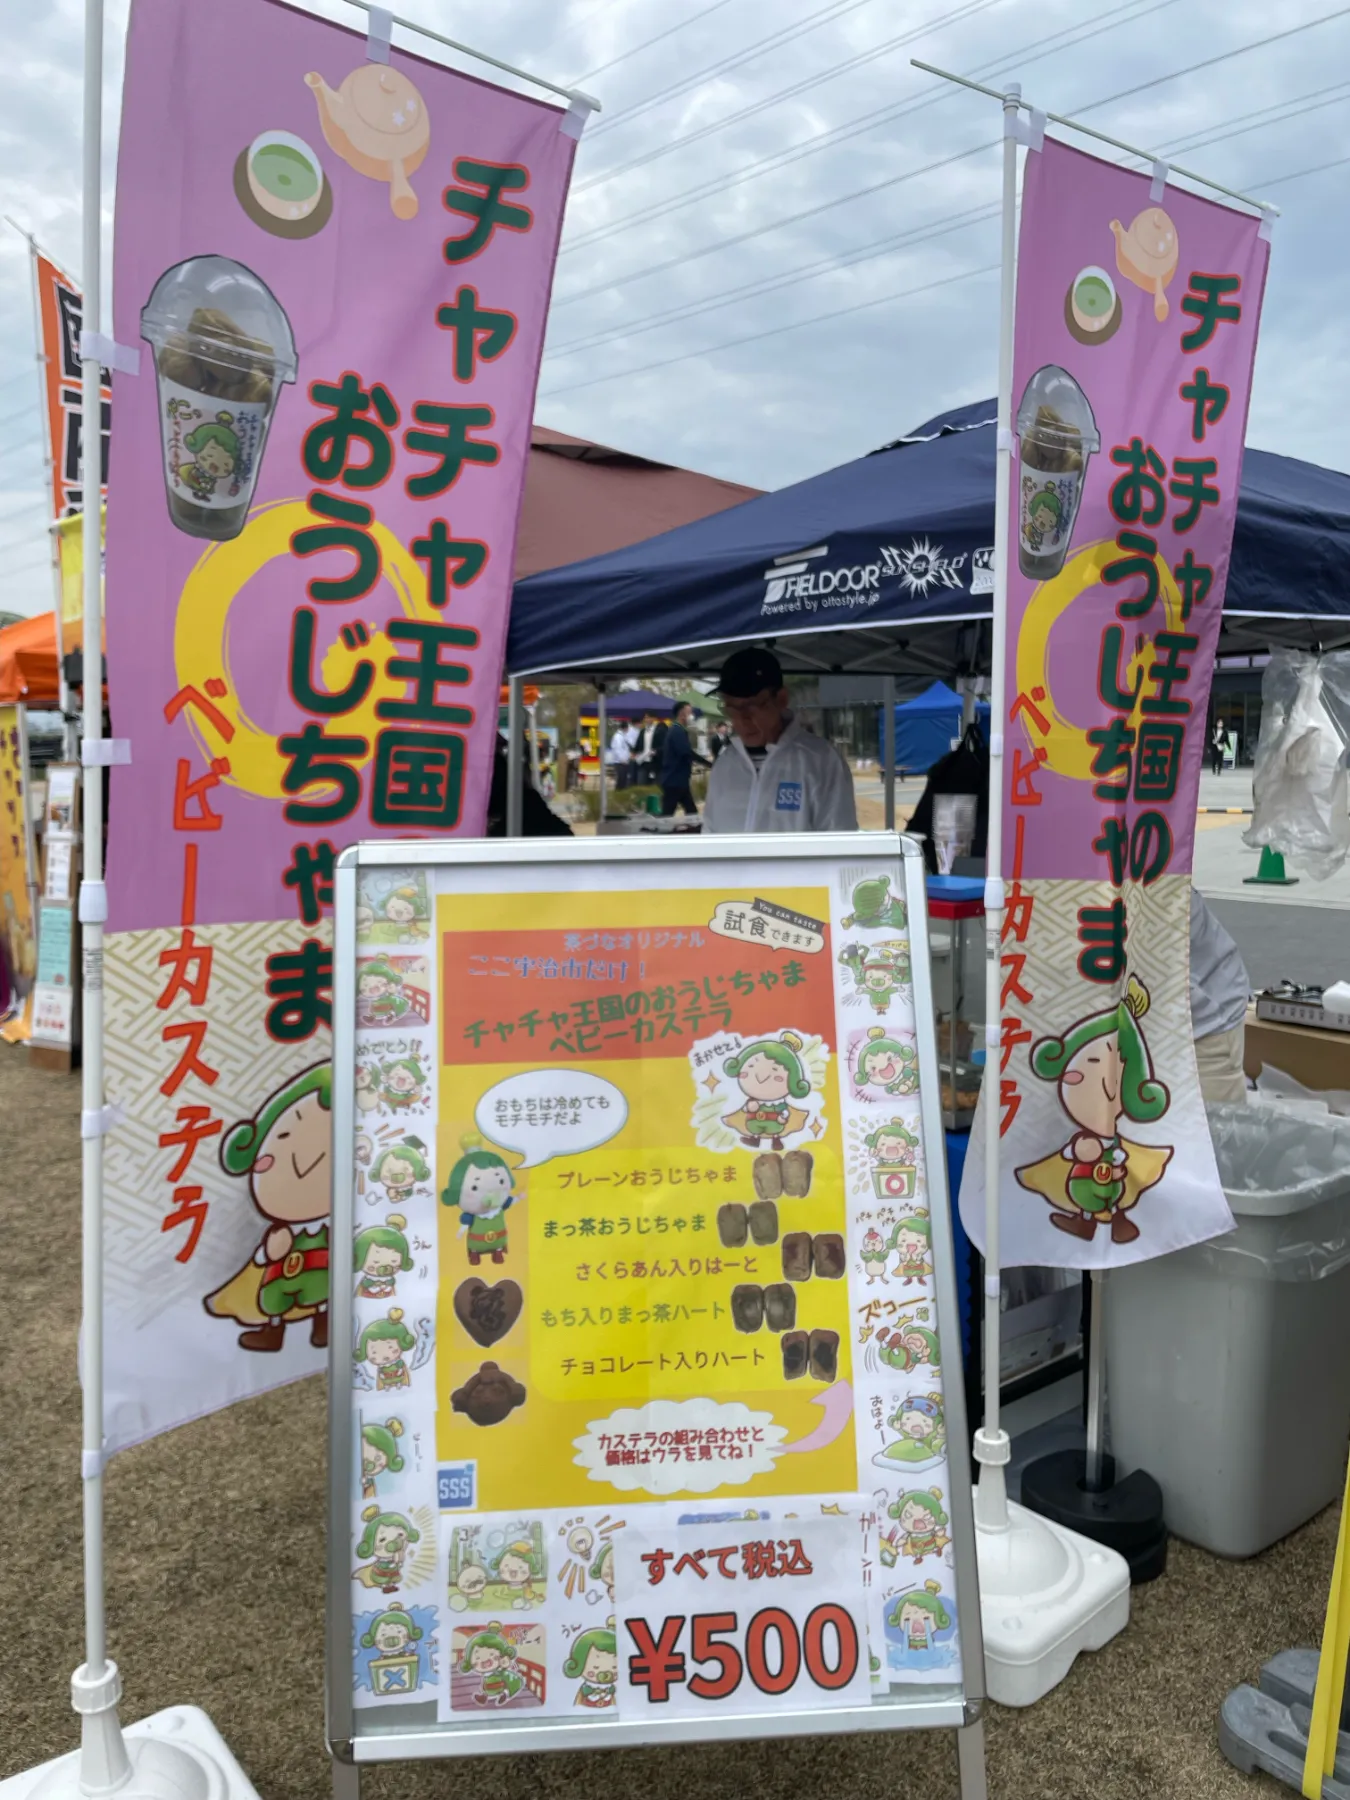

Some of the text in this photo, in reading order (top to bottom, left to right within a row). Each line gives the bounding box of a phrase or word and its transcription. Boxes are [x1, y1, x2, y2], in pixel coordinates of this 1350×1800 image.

[368, 156, 533, 838] チャチャ王国
[1129, 271, 1242, 887] チャチャ王国の
[760, 597, 802, 616] Powered
[805, 596, 819, 613] by
[264, 370, 401, 1044] おうじちゃま
[1077, 436, 1167, 985] おうじちゃま
[759, 902, 817, 930] You can taste
[1000, 685, 1051, 1140] ベビーカステラ
[723, 909, 815, 947] 試食できます
[156, 677, 236, 1264] ベビーカステラ
[468, 956, 647, 983] ここ宇治市だけ！
[462, 960, 807, 1049] チャチャ王国のおうじちゃま
[549, 1001, 733, 1055] ベビーカステラ
[494, 1096, 610, 1113] おもちは冷めても
[495, 1111, 582, 1128] モチモチだよ
[557, 1165, 738, 1189] プレーンおうじちゃま
[543, 1214, 707, 1239] まっ茶おうじちゃま
[576, 1256, 759, 1281] さくらあん入りはーと
[541, 1301, 726, 1328] もち入りまっ茶ハート
[560, 1348, 766, 1377] チョコレート入りハート
[597, 1425, 765, 1450] カステラの組み合わせと
[605, 1444, 754, 1467] 価格はウラを見てね！
[440, 1477, 470, 1500] SSS
[641, 1538, 813, 1587] すべて税込
[624, 1602, 860, 1703] ¥500
